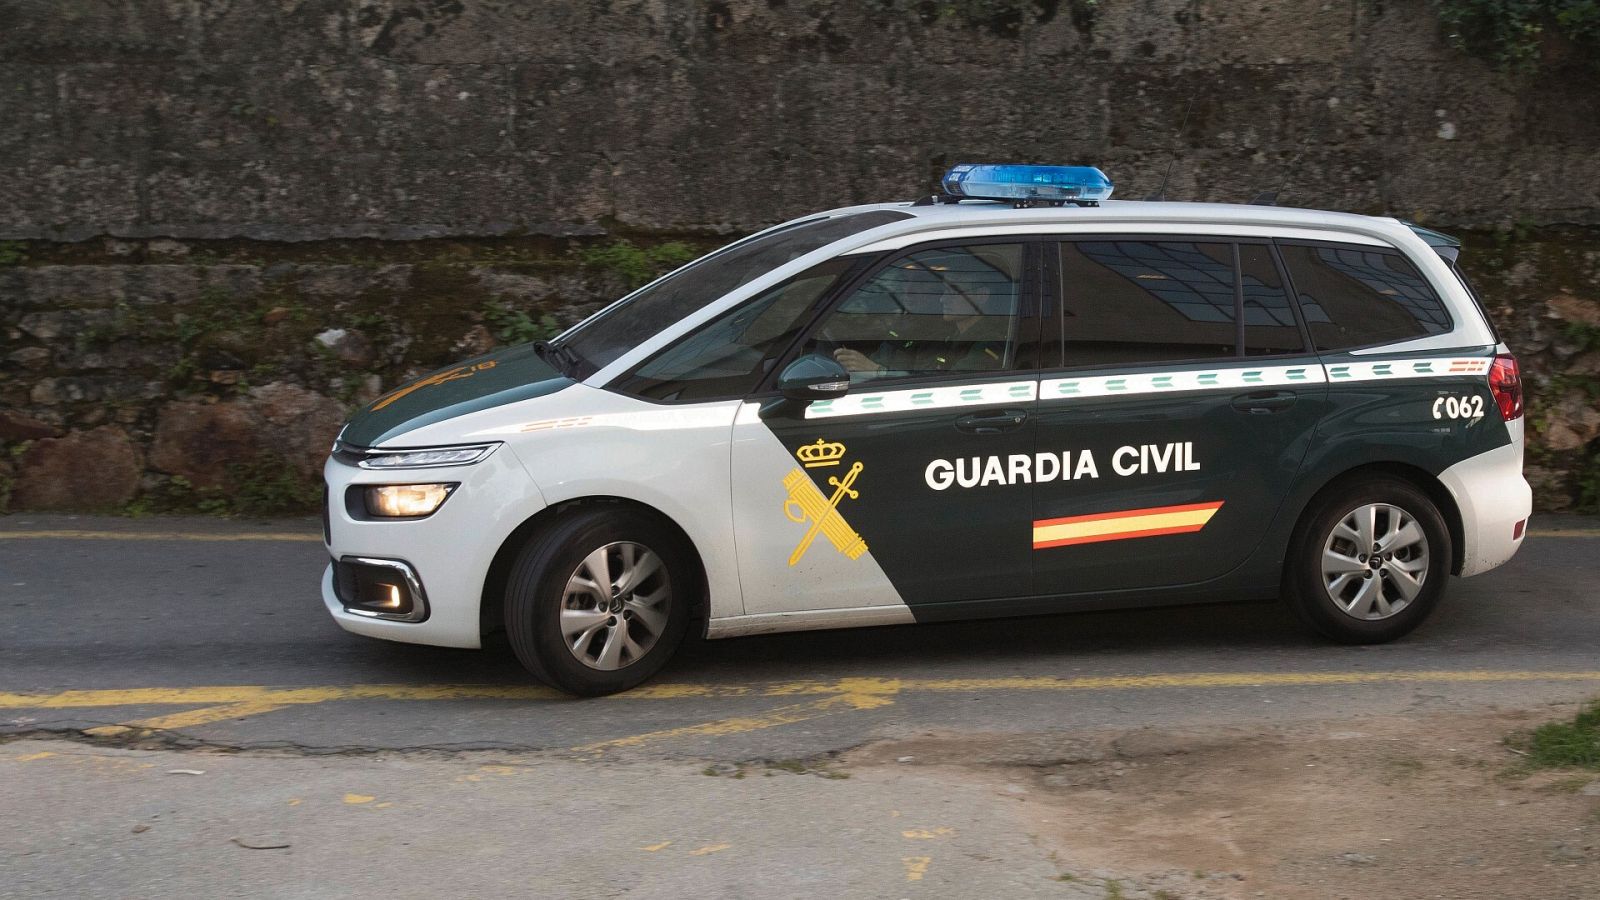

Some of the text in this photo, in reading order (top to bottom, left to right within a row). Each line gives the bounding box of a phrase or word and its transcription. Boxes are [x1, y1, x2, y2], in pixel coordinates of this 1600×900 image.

[1445, 394, 1485, 420] 062
[924, 441, 1201, 491] GUARDIA CIVIL
